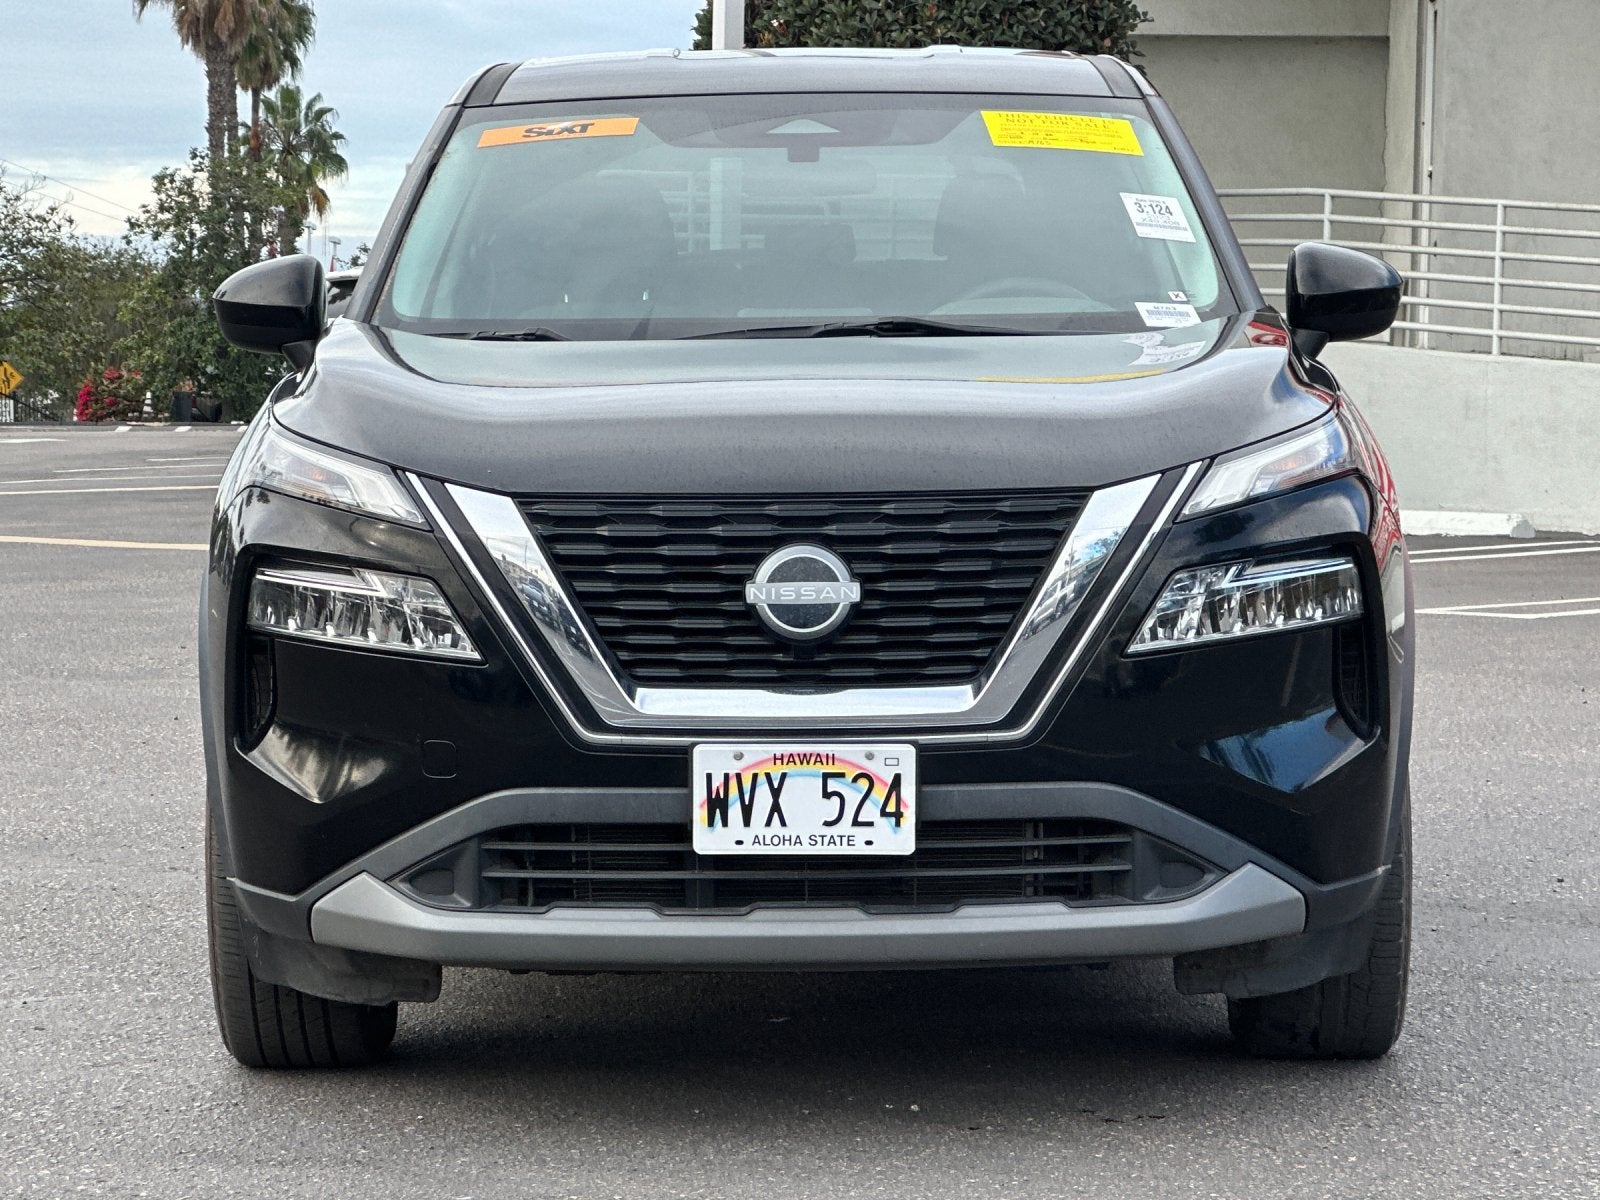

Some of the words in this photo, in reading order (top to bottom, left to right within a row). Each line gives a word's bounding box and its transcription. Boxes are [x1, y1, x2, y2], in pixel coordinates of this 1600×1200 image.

[522, 122, 595, 138] SIXT
[1134, 201, 1173, 216] 3:124
[750, 587, 857, 600] NISSAN
[773, 753, 836, 766] HAWAII
[705, 772, 788, 828] WVX
[821, 772, 904, 828] 524
[751, 834, 803, 847] ALOHA
[808, 834, 856, 847] STATE
